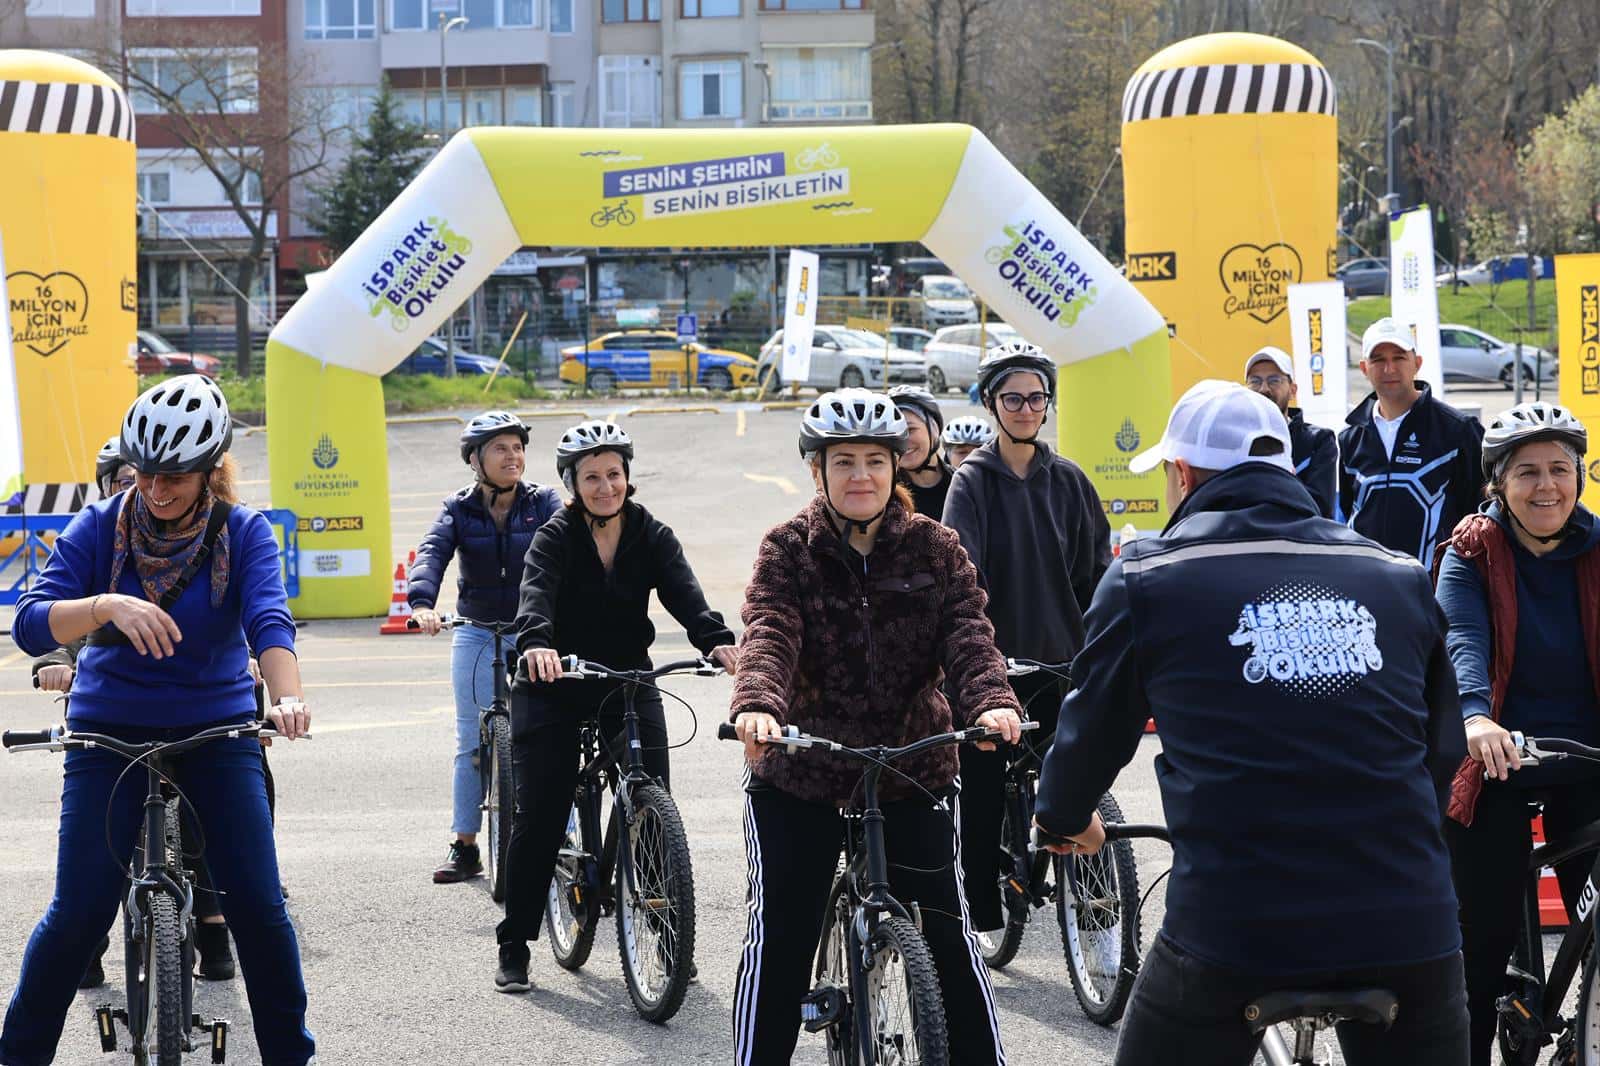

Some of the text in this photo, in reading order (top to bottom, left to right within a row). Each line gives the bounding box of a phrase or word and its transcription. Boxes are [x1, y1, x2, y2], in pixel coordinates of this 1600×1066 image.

[619, 157, 773, 193] SENİN ŞEHRİN
[653, 172, 843, 214] SENİN BİSİKLETİN
[386, 240, 447, 306] Bisiklet
[1013, 242, 1075, 303] Bisiklet
[1127, 255, 1172, 278] ARK
[1255, 257, 1271, 269] 16
[35, 286, 53, 298] 16
[404, 253, 466, 318] Okulu
[999, 260, 1061, 322] Okulu
[299, 516, 361, 532] SPARK
[1269, 651, 1368, 680] Okulu
